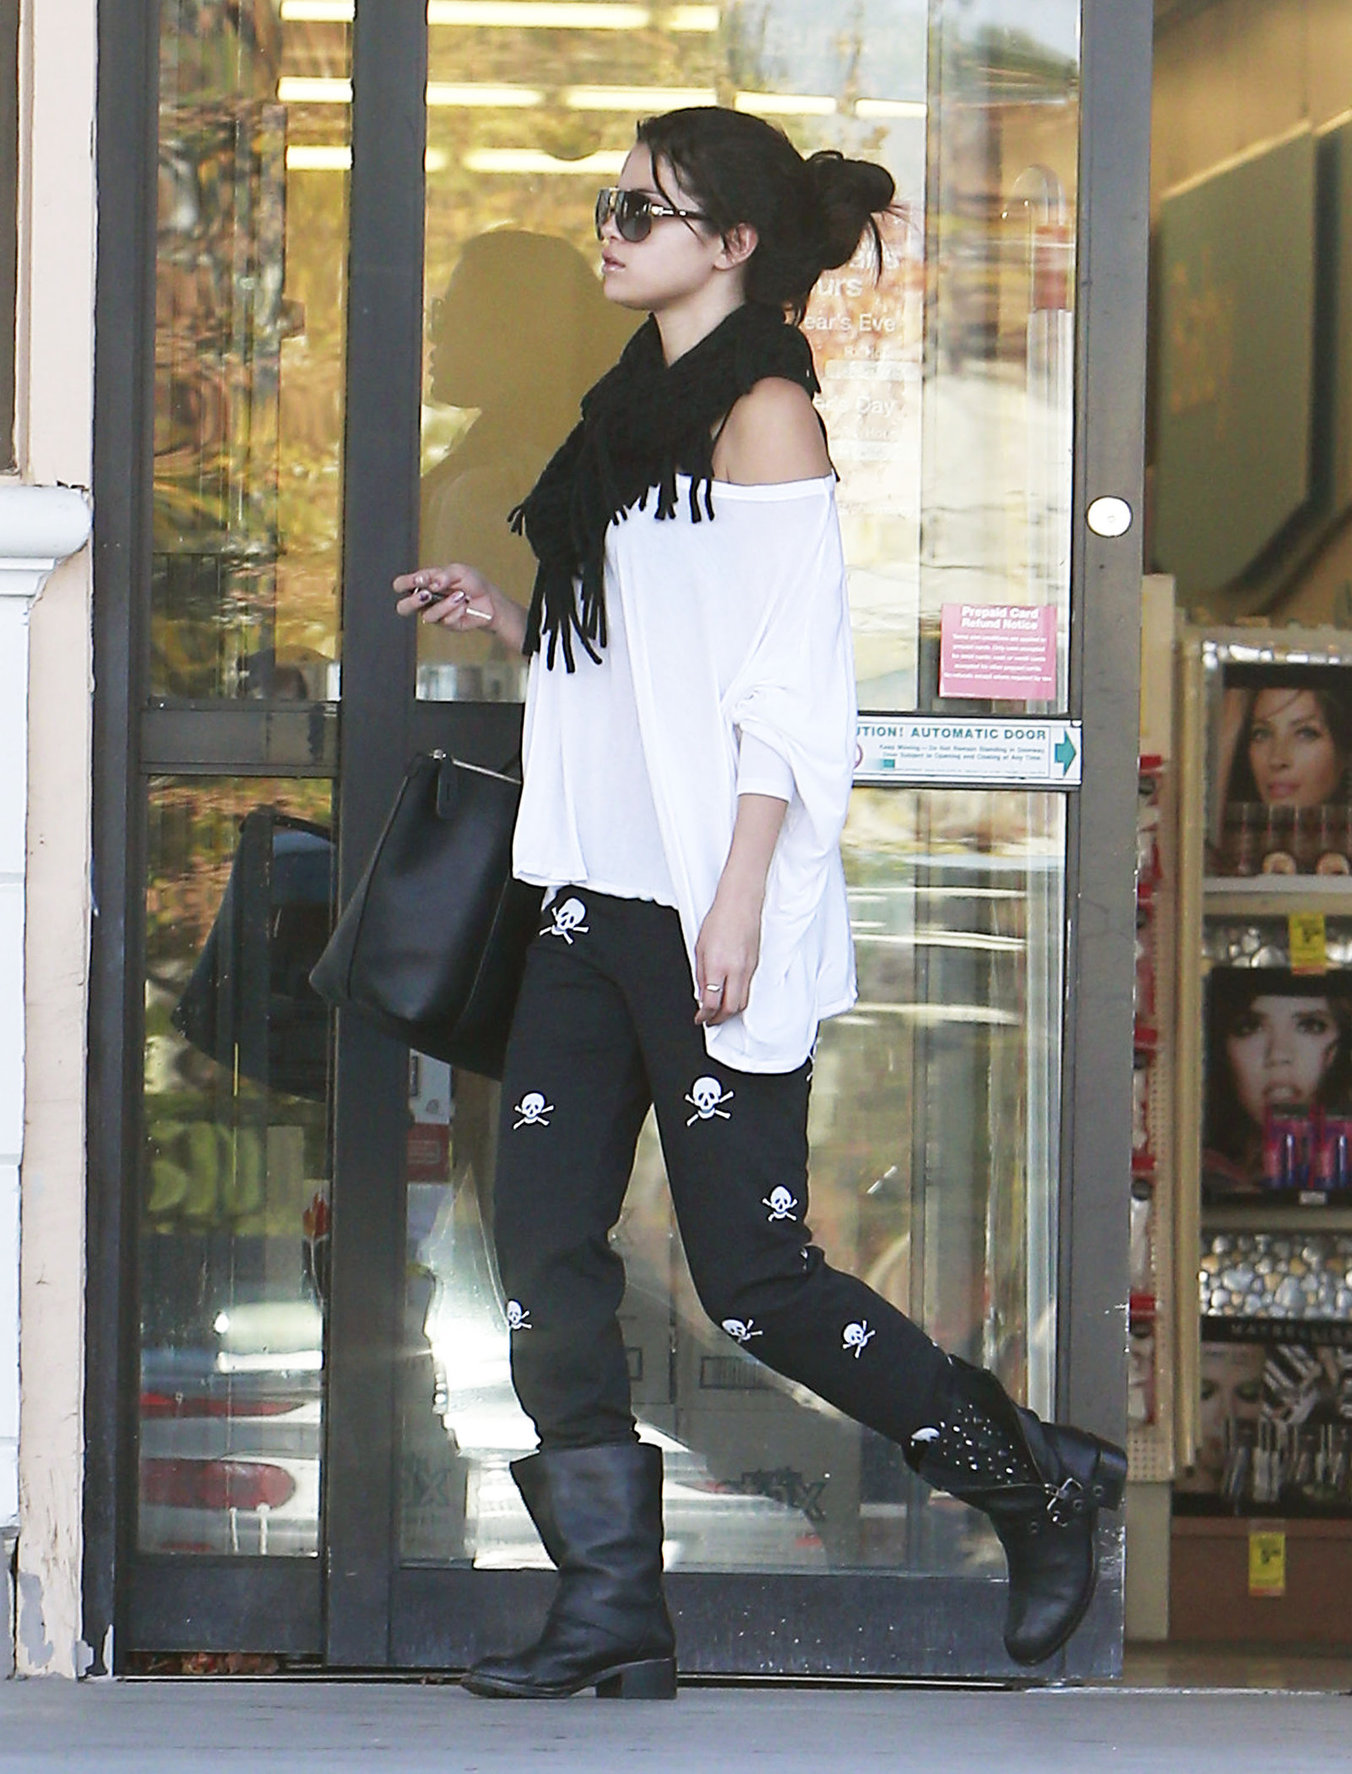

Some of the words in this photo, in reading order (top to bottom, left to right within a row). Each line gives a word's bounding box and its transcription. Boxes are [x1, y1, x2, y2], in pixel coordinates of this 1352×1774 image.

[817, 278, 863, 297] urs
[804, 313, 851, 331] ear's
[860, 313, 896, 332] Eve
[857, 396, 895, 418] Day
[961, 605, 1008, 619] Prepaid
[1009, 607, 1039, 619] Card
[961, 617, 1001, 629] Refund
[1002, 619, 1038, 630] Notice
[857, 726, 904, 737] TION!
[911, 727, 999, 739] AUTOMATIC
[1004, 729, 1046, 740] DOOR
